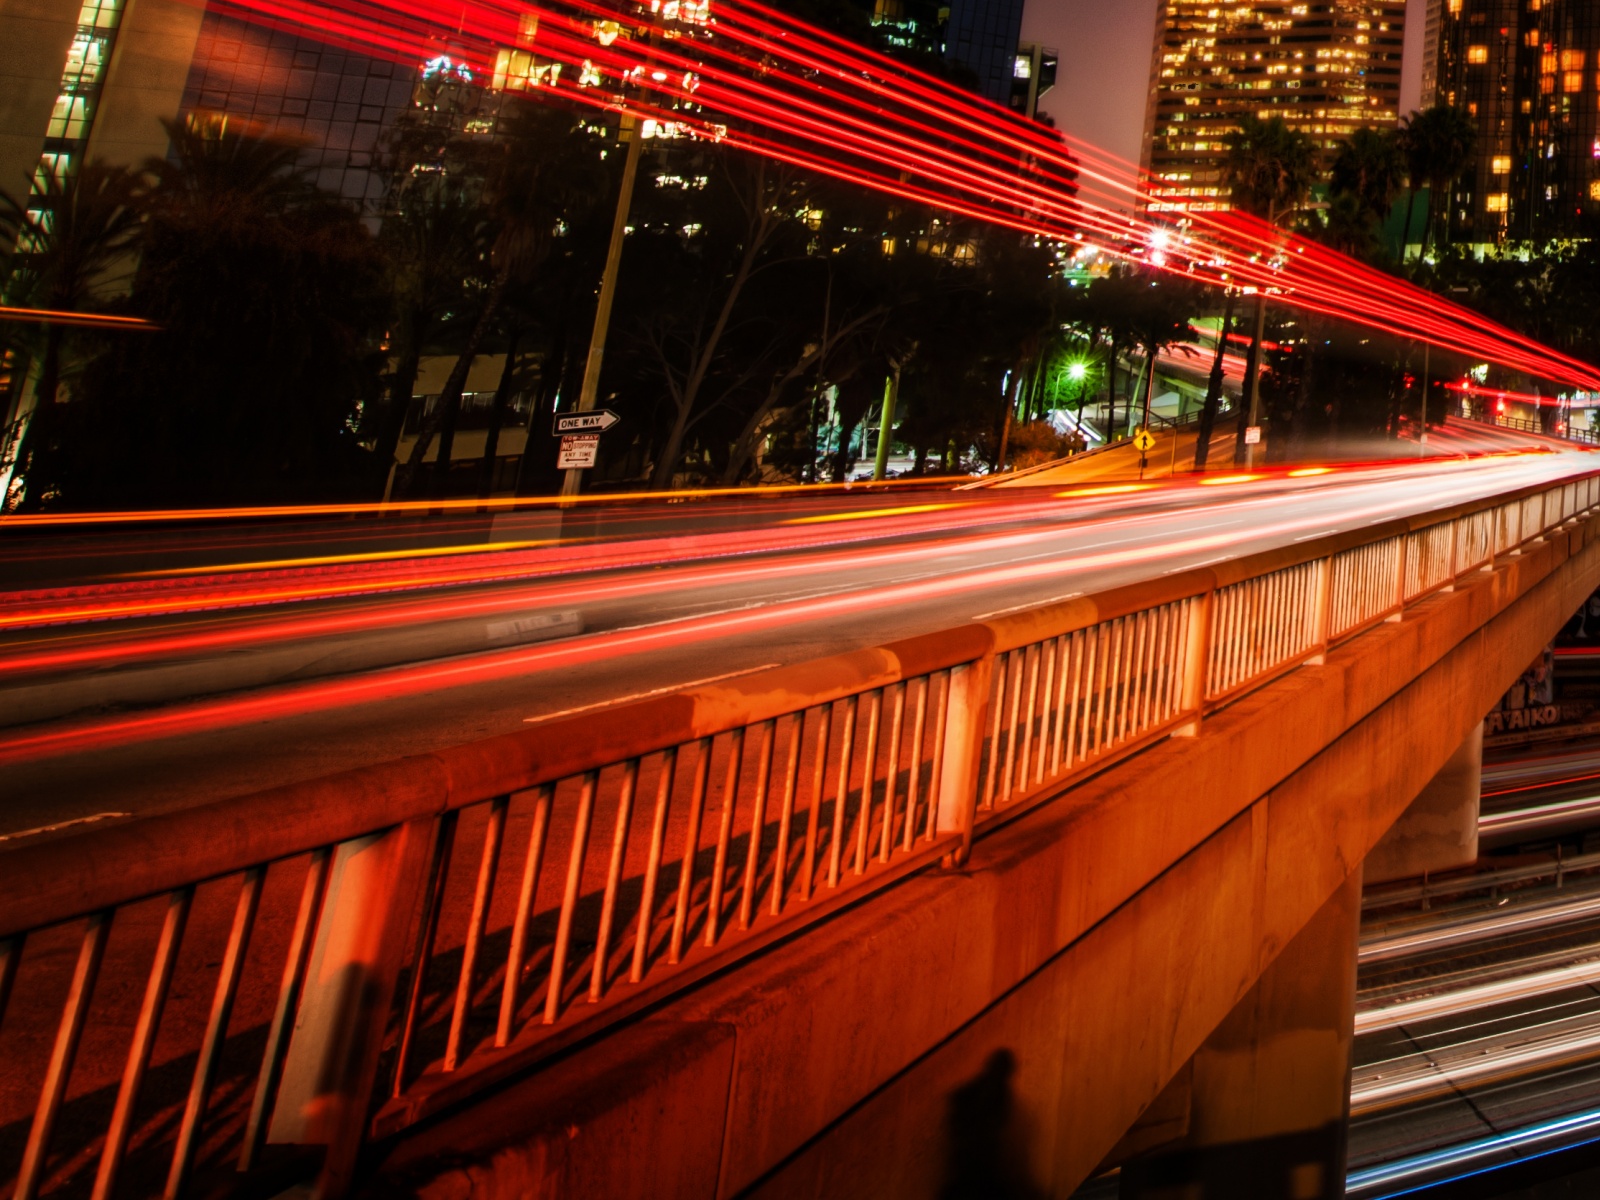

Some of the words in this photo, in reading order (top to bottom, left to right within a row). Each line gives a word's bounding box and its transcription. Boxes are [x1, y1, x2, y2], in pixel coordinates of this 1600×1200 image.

[561, 419, 579, 428] ONE
[582, 417, 601, 426] WAY
[562, 441, 572, 451] NO
